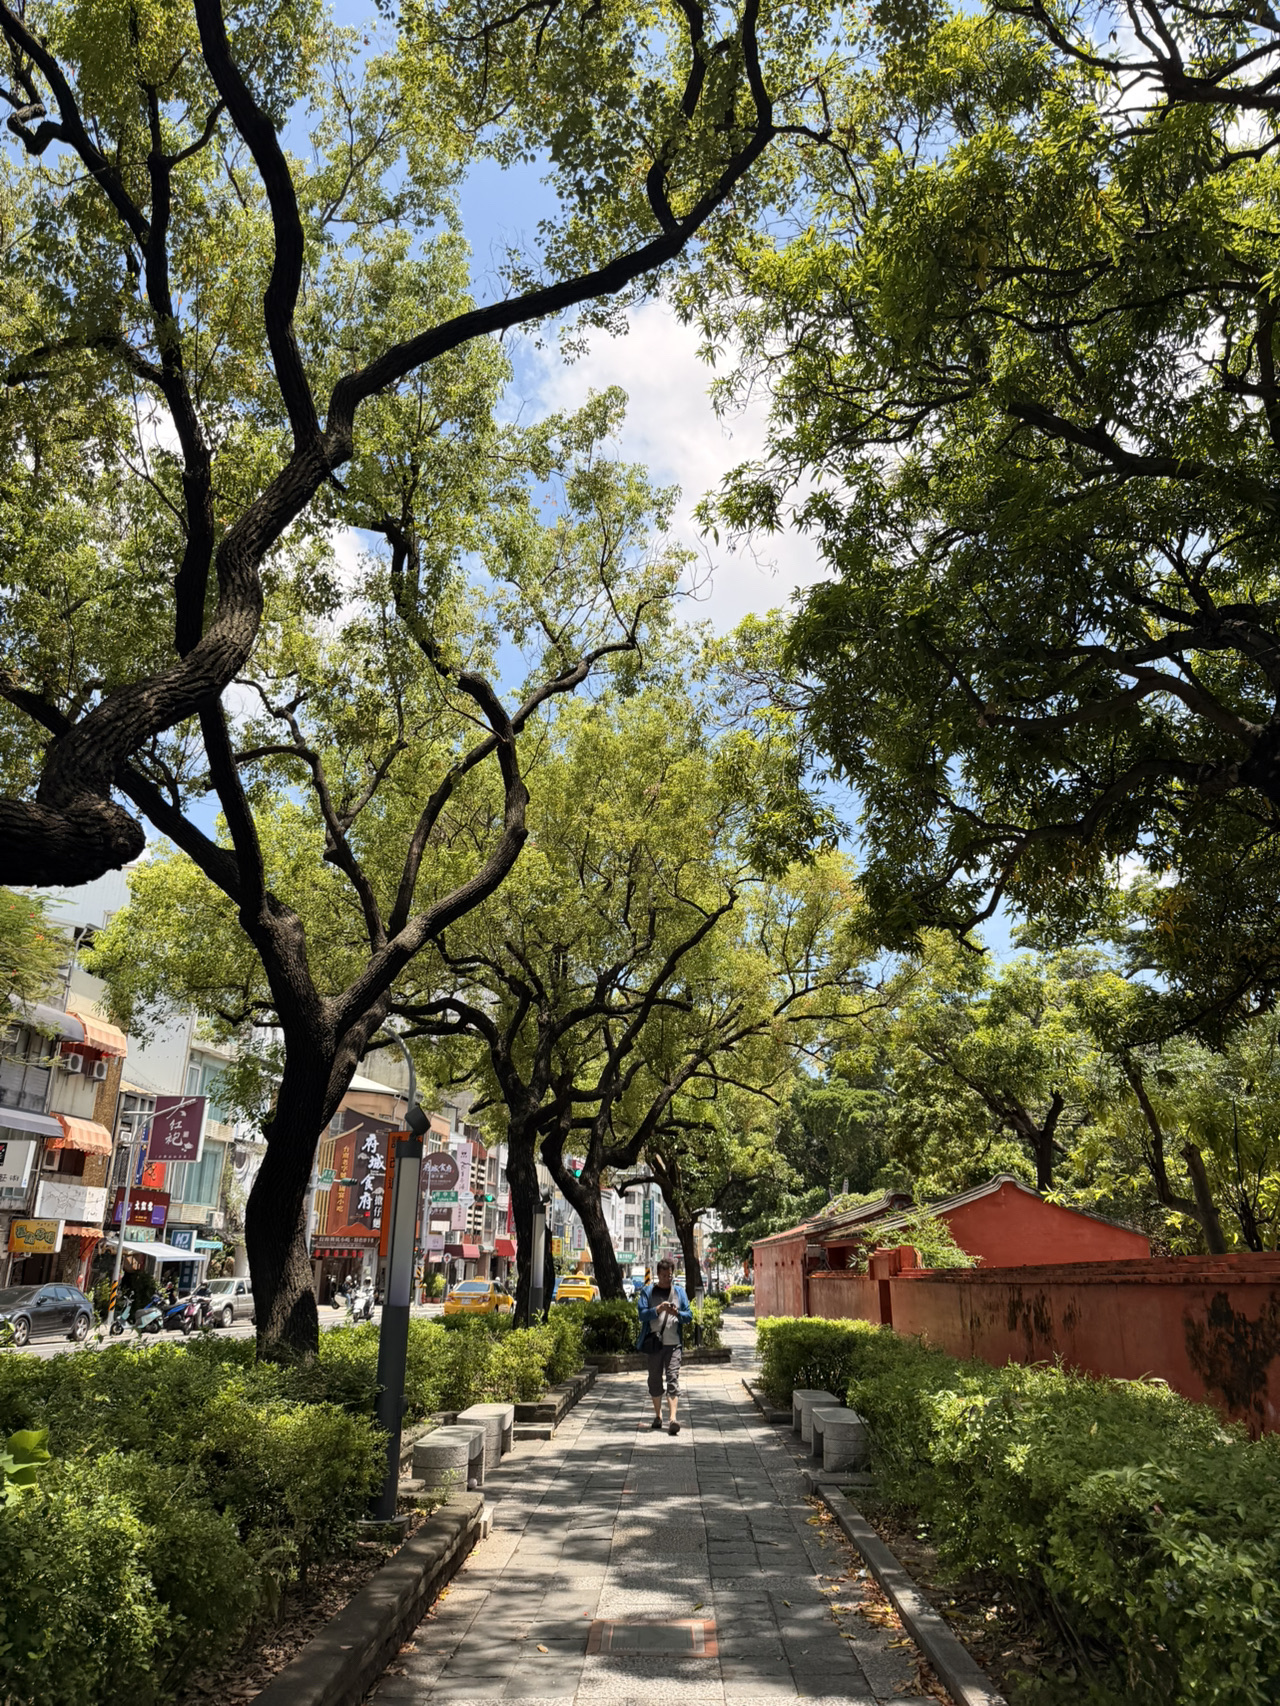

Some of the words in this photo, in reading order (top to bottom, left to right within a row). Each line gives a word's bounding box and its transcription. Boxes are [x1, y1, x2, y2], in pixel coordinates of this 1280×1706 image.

[358, 1133, 387, 1210] 府城食府
[422, 1162, 452, 1173] 府城食府
